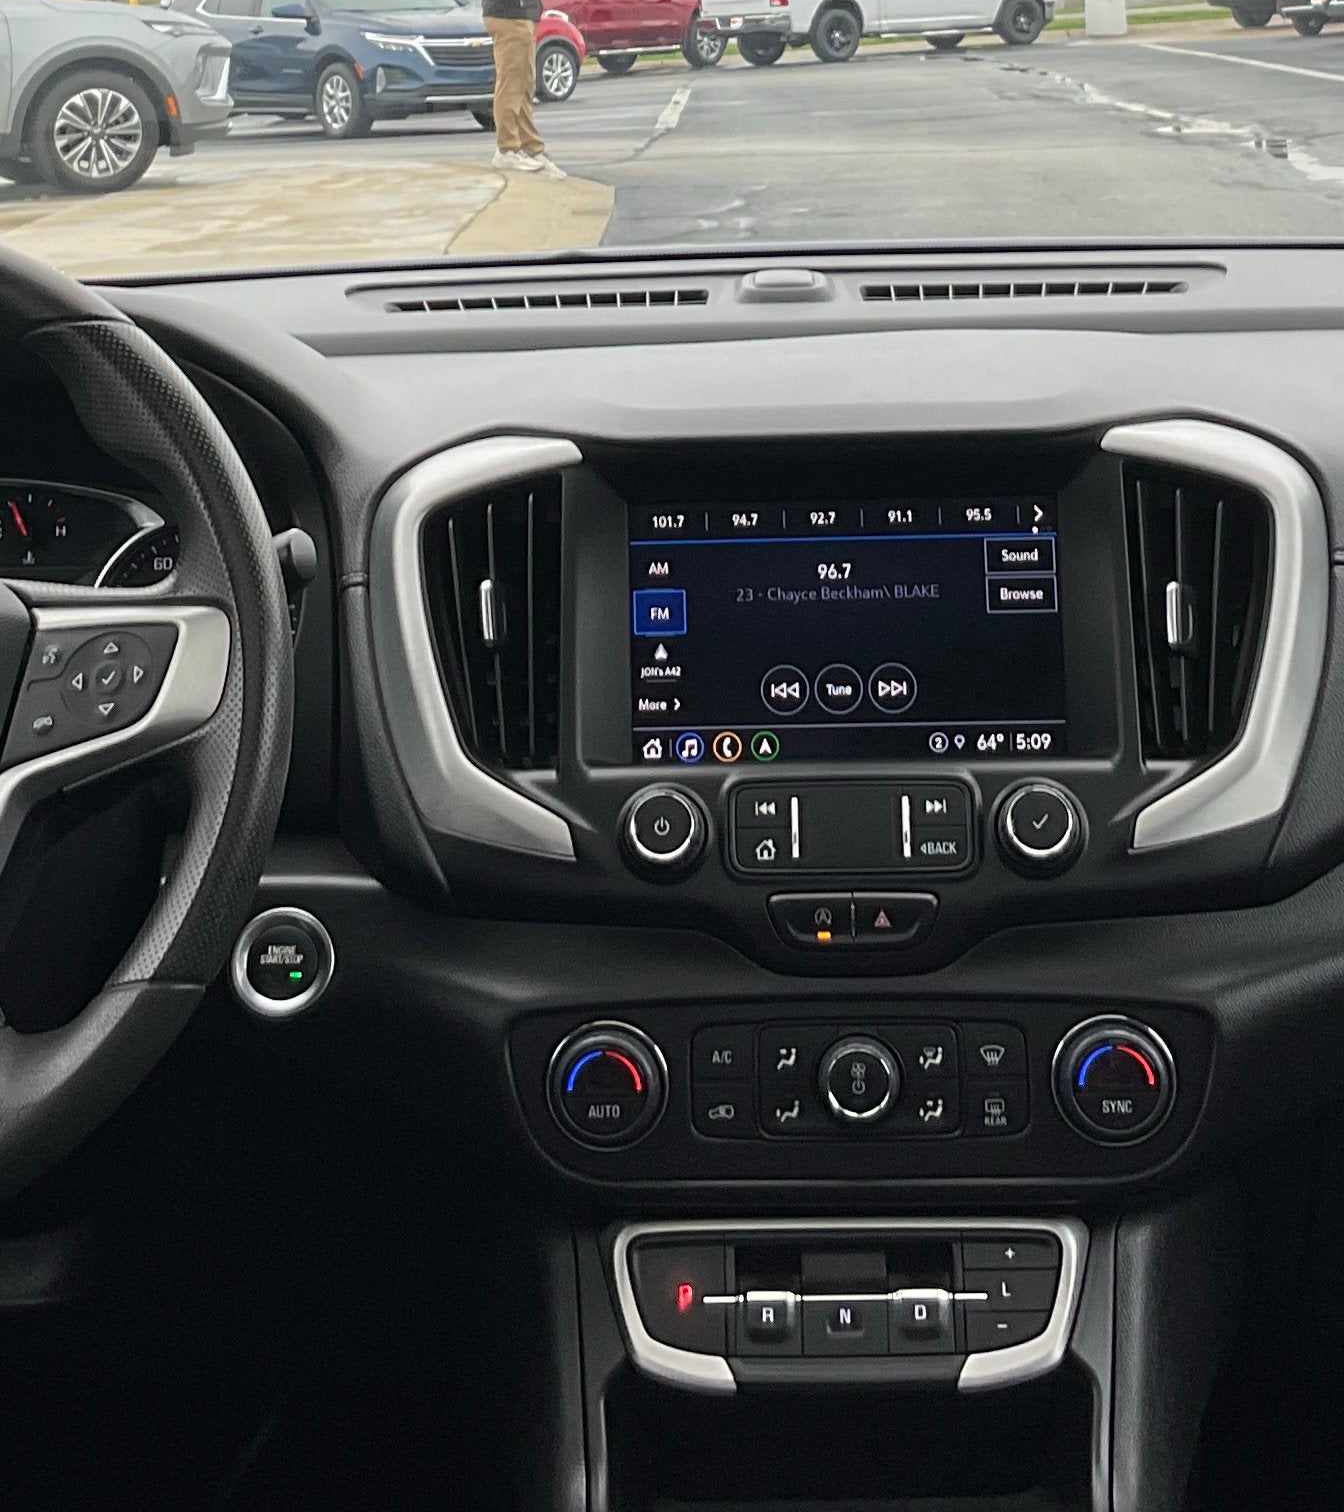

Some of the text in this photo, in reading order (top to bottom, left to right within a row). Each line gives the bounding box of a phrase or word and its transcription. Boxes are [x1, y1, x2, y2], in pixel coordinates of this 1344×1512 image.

[652, 514, 685, 529] 101.7
[810, 511, 837, 525] 92.7
[887, 509, 914, 524] 91.1
[965, 507, 993, 522] 95.5
[55, 525, 66, 537] H
[153, 556, 173, 571] 60
[1001, 548, 1039, 563] Sound
[648, 562, 669, 576] AM
[817, 562, 852, 580] 96.7
[736, 587, 754, 603] 23
[767, 587, 818, 605] Chayce
[894, 583, 940, 599] BLAKE
[999, 586, 1044, 602] Browse
[649, 606, 670, 621] FM
[826, 683, 852, 697] Tune
[638, 698, 667, 712] More
[1016, 732, 1052, 751] 5:09
[925, 839, 957, 855] BACK
[711, 1049, 732, 1066] A/C
[588, 1104, 620, 1120] AUTO
[1101, 1099, 1133, 1115] SYNC
[677, 1282, 693, 1303] P
[1002, 1281, 1011, 1297] L
[761, 1306, 774, 1323] R
[838, 1307, 852, 1325] N
[913, 1304, 927, 1321] D
